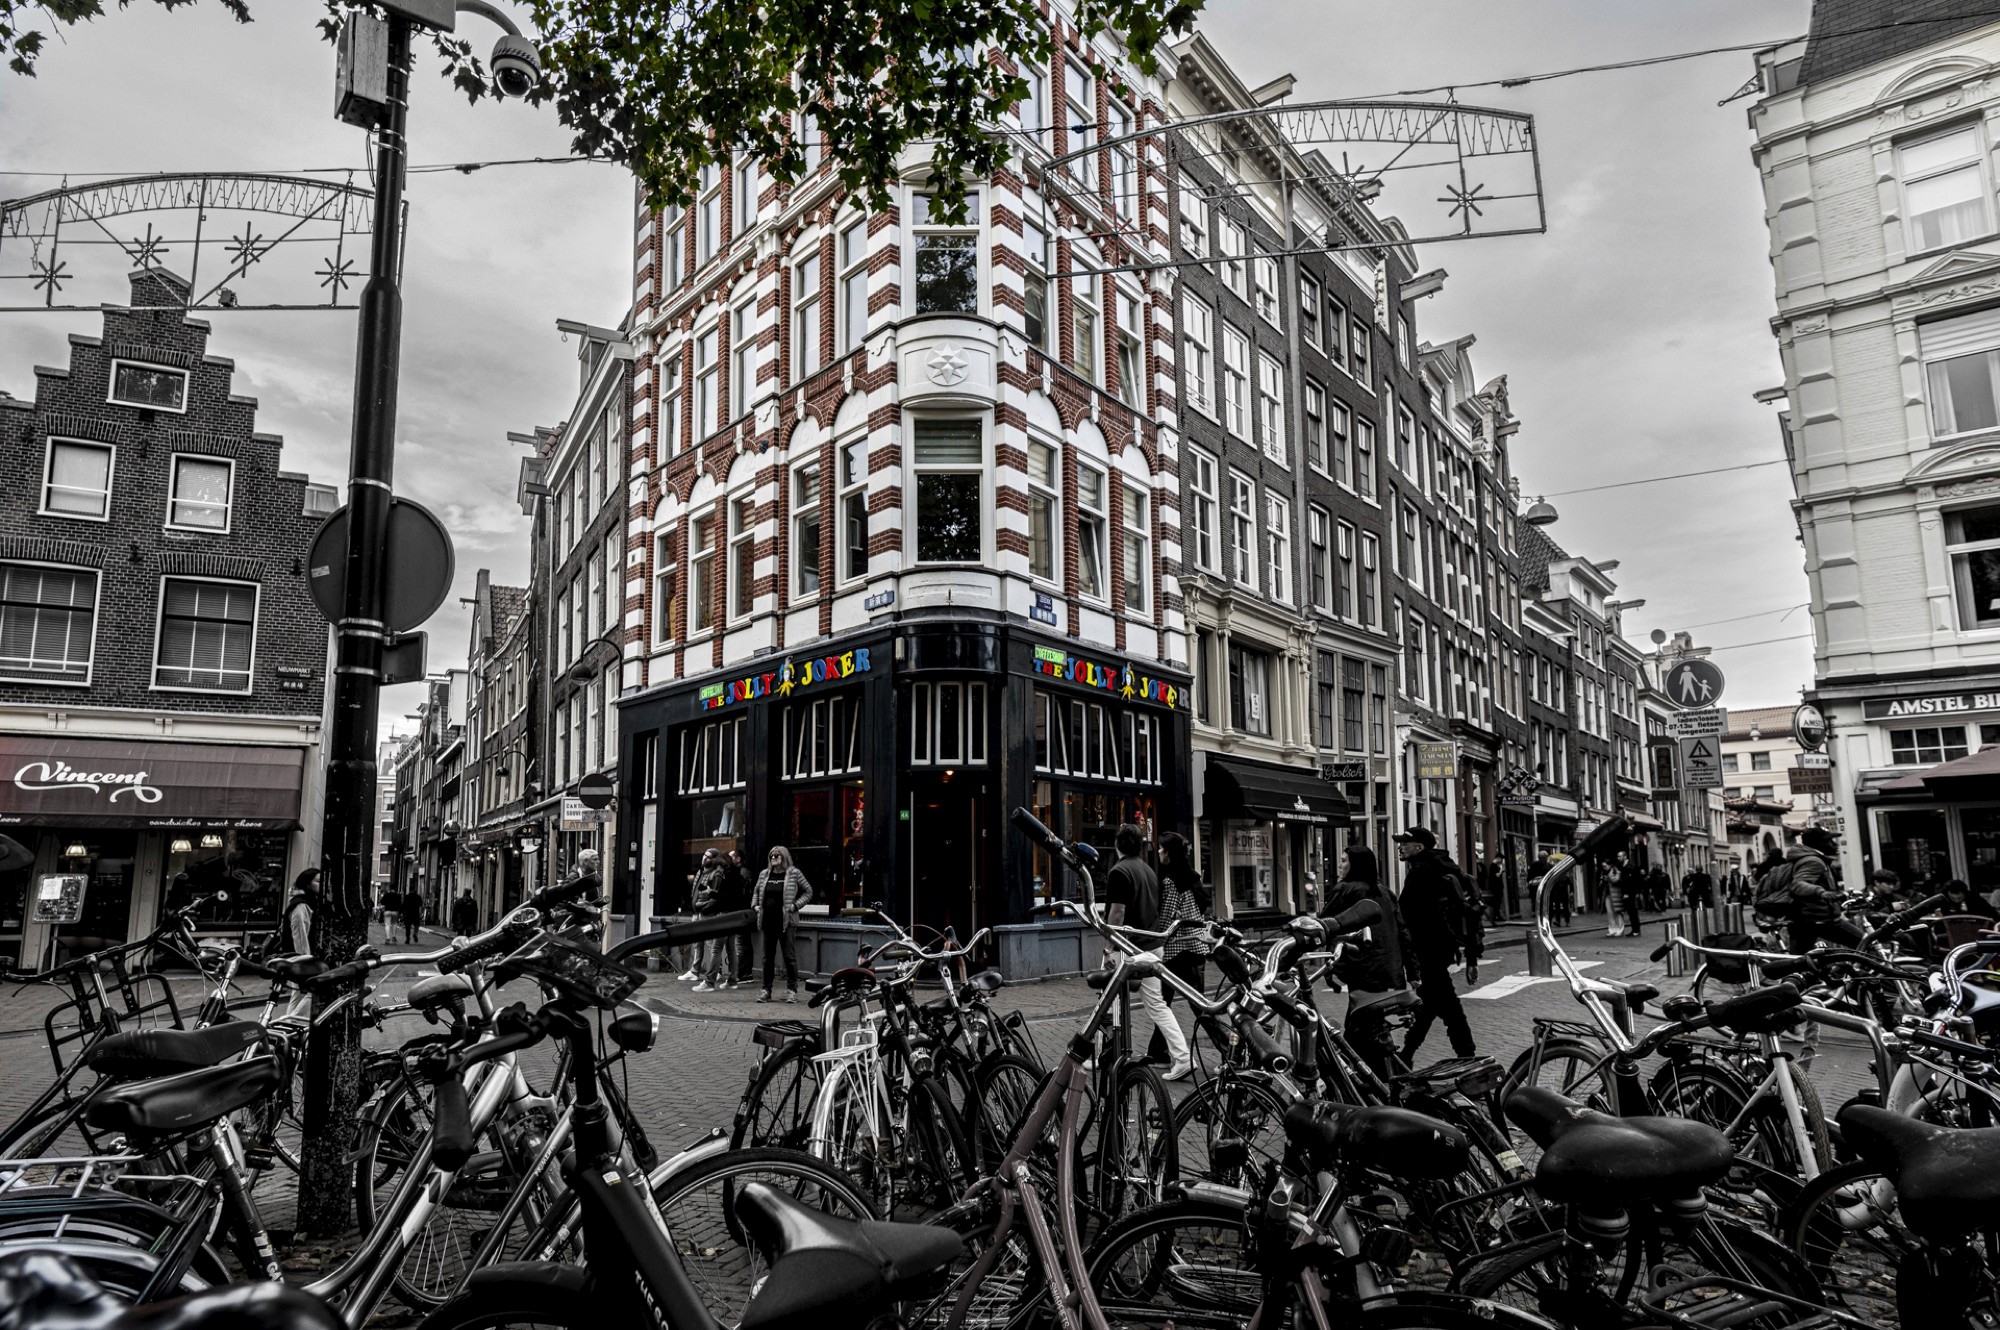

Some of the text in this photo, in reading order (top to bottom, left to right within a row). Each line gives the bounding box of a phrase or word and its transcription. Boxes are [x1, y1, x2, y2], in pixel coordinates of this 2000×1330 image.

[277, 666, 311, 674] NIEUWMARKT
[702, 648, 871, 711] THE JOLLY JOKER
[1032, 657, 1190, 710] THE JOLLY JOKER
[1673, 708, 1720, 718] uitgezonderd
[1887, 695, 1970, 716] AMSTEL
[1678, 728, 1720, 736] toegestaan
[1323, 764, 1364, 780] Grolsch
[14, 761, 163, 803] Vincent
[149, 818, 263, 828] sandwiches meat cheese
